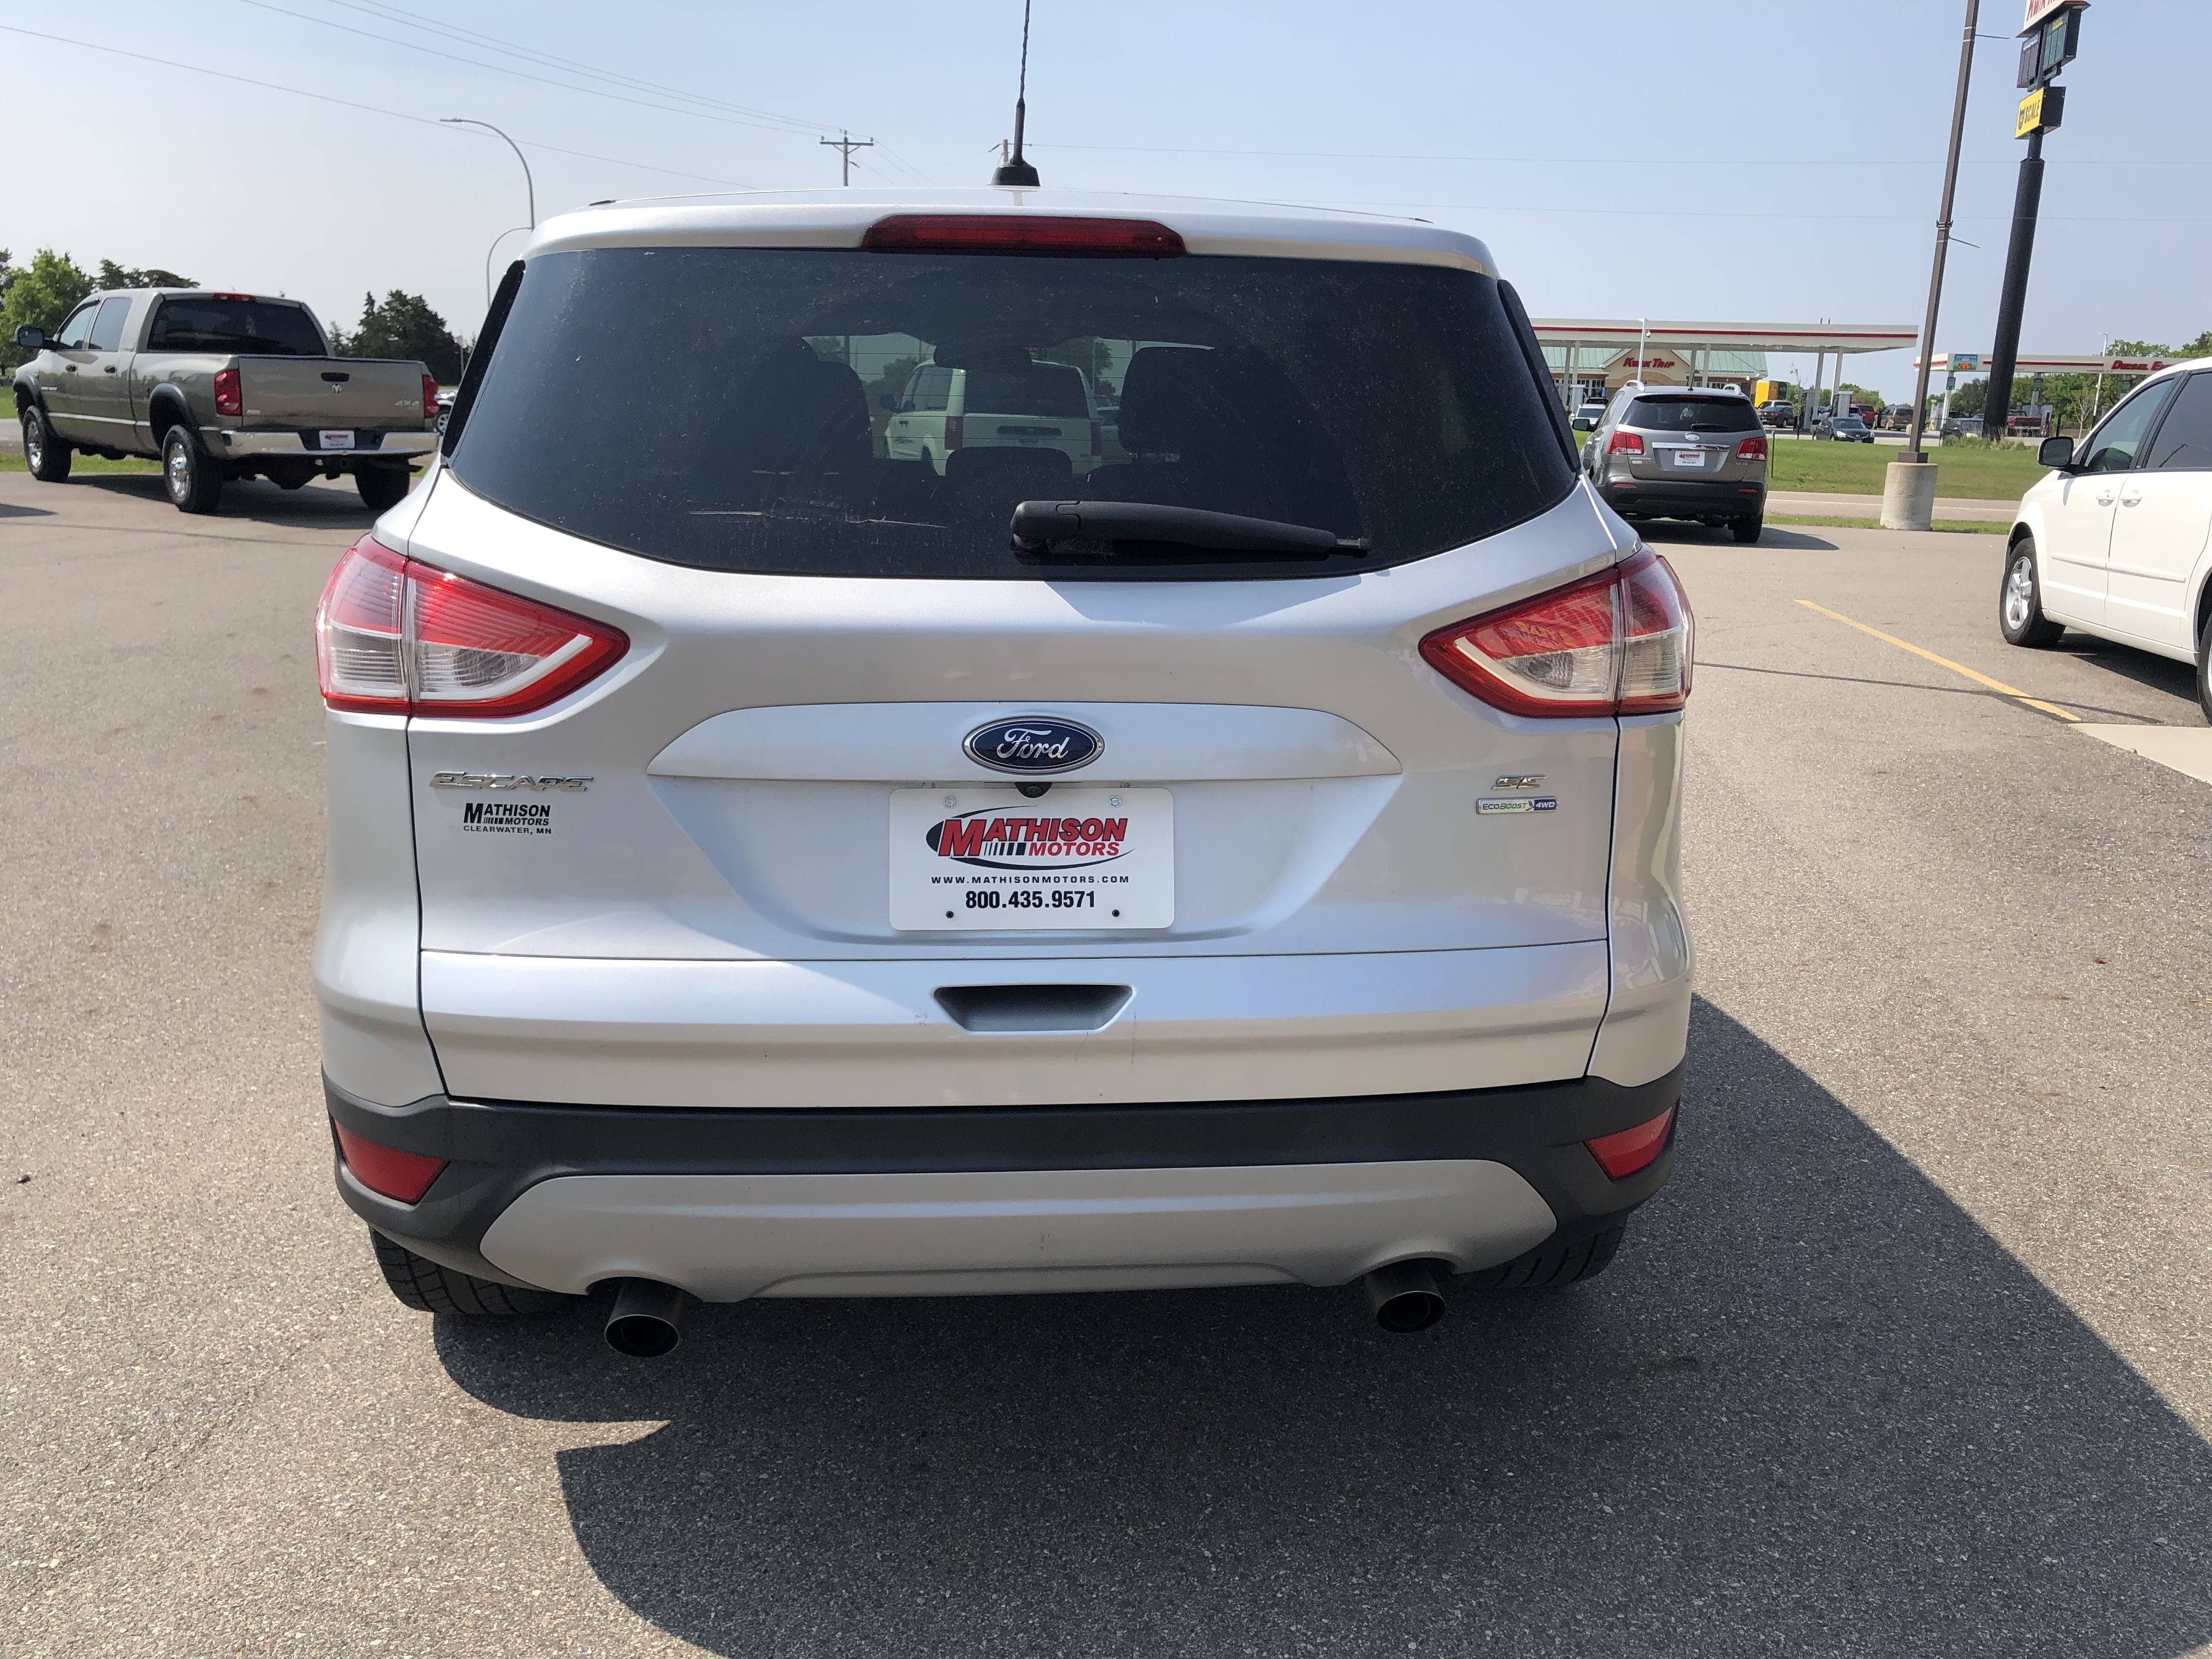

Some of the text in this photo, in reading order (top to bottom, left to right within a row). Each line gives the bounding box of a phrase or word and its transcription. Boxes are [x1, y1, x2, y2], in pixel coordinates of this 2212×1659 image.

[1652, 358, 1675, 368] TRIP
[996, 728, 1070, 759] Ford
[430, 771, 594, 792] ESCAPE
[464, 803, 550, 823] MATHISON
[1482, 803, 1527, 811] ECOBOOST
[505, 817, 550, 826] MOTORS
[464, 825, 533, 835] CLEARWATER,
[938, 817, 1128, 857] MATHISON
[1028, 842, 1120, 856] MOTORS
[931, 876, 1129, 884] WWW.MATHISONMOTORS.COM
[965, 890, 1095, 909] 800.435.9571
